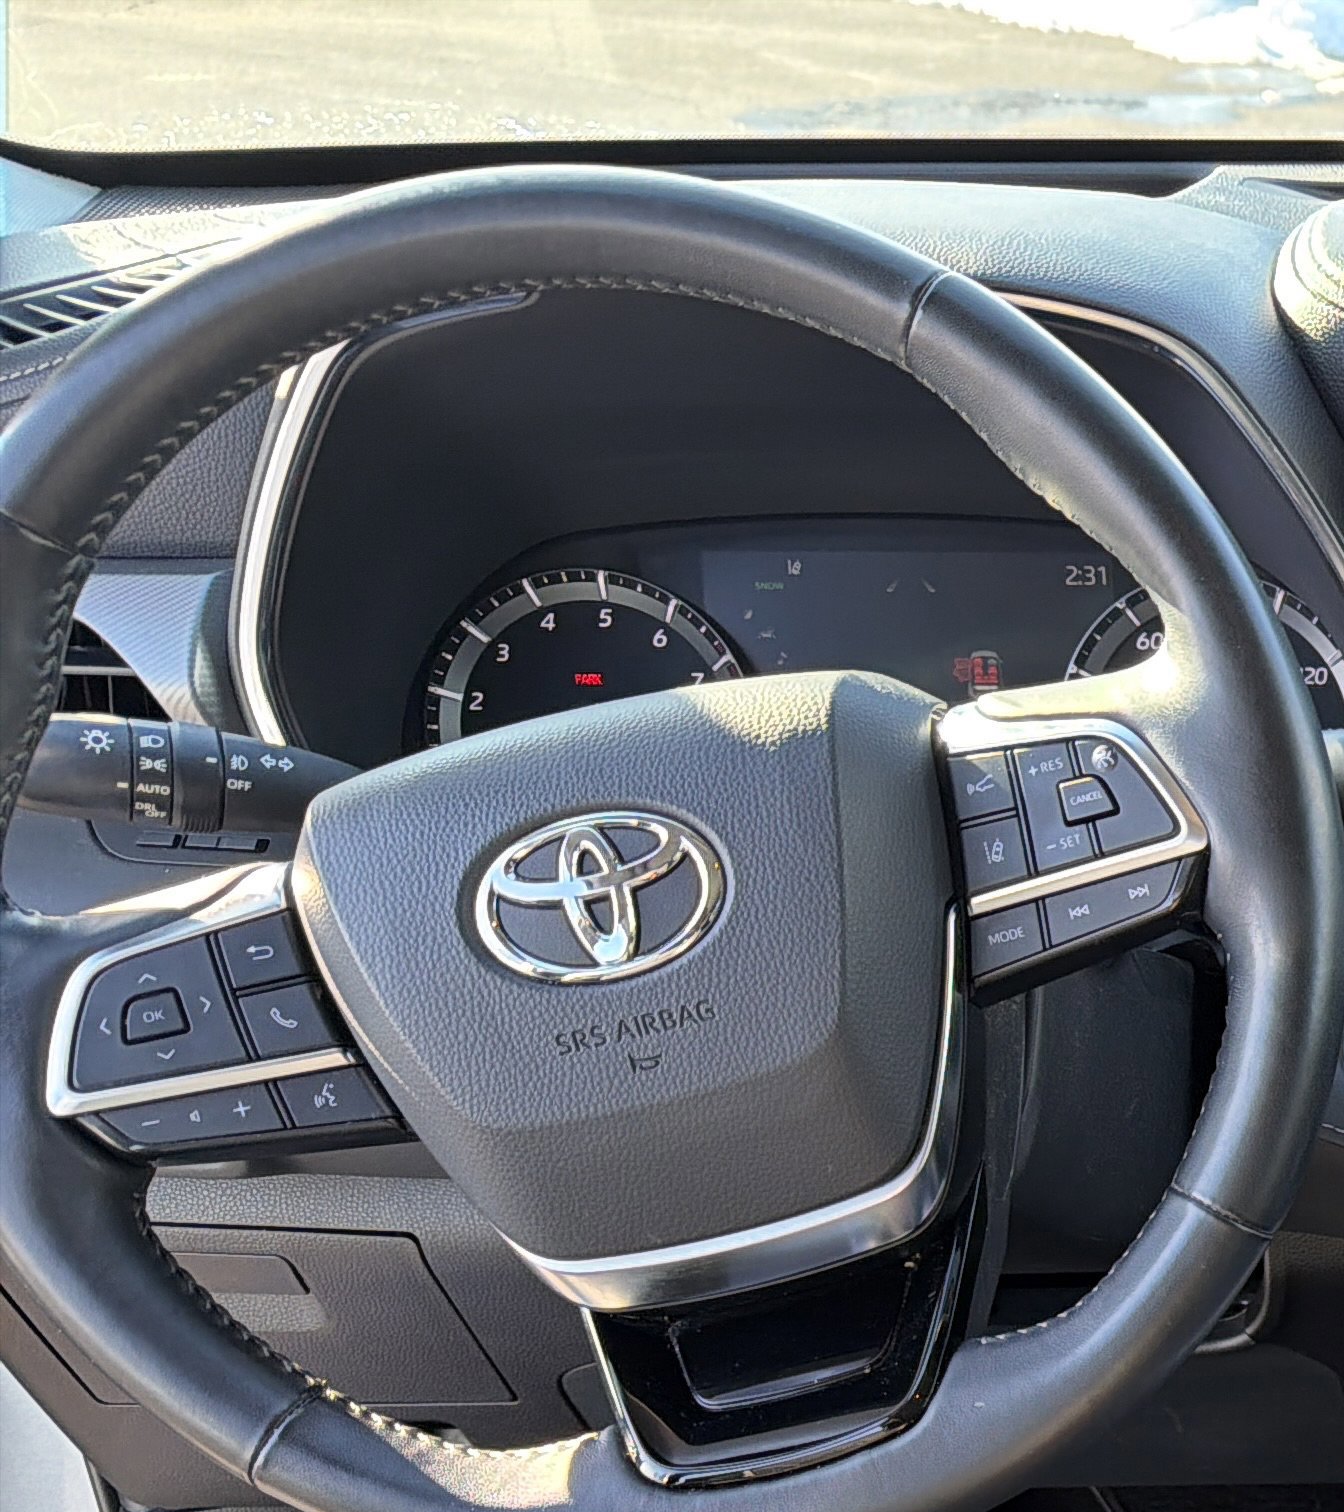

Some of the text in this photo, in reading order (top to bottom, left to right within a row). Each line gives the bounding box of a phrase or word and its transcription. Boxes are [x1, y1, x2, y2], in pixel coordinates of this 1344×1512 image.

[1065, 565, 1107, 586] 2:31
[539, 611, 557, 632] 4
[598, 608, 613, 628] 5
[652, 629, 668, 648] 6
[1135, 631, 1164, 651] 60
[495, 643, 511, 663] 3
[1300, 666, 1328, 686] 20
[468, 691, 484, 711] 2
[136, 782, 171, 796] AUTO
[227, 778, 253, 792] OFF
[134, 802, 157, 812] DRL
[1069, 790, 1103, 806] CANCEL
[144, 811, 167, 819] OFF
[987, 925, 1026, 947] MODE
[143, 1010, 165, 1024] OK
[554, 999, 717, 1057] SRS AIRBAG
